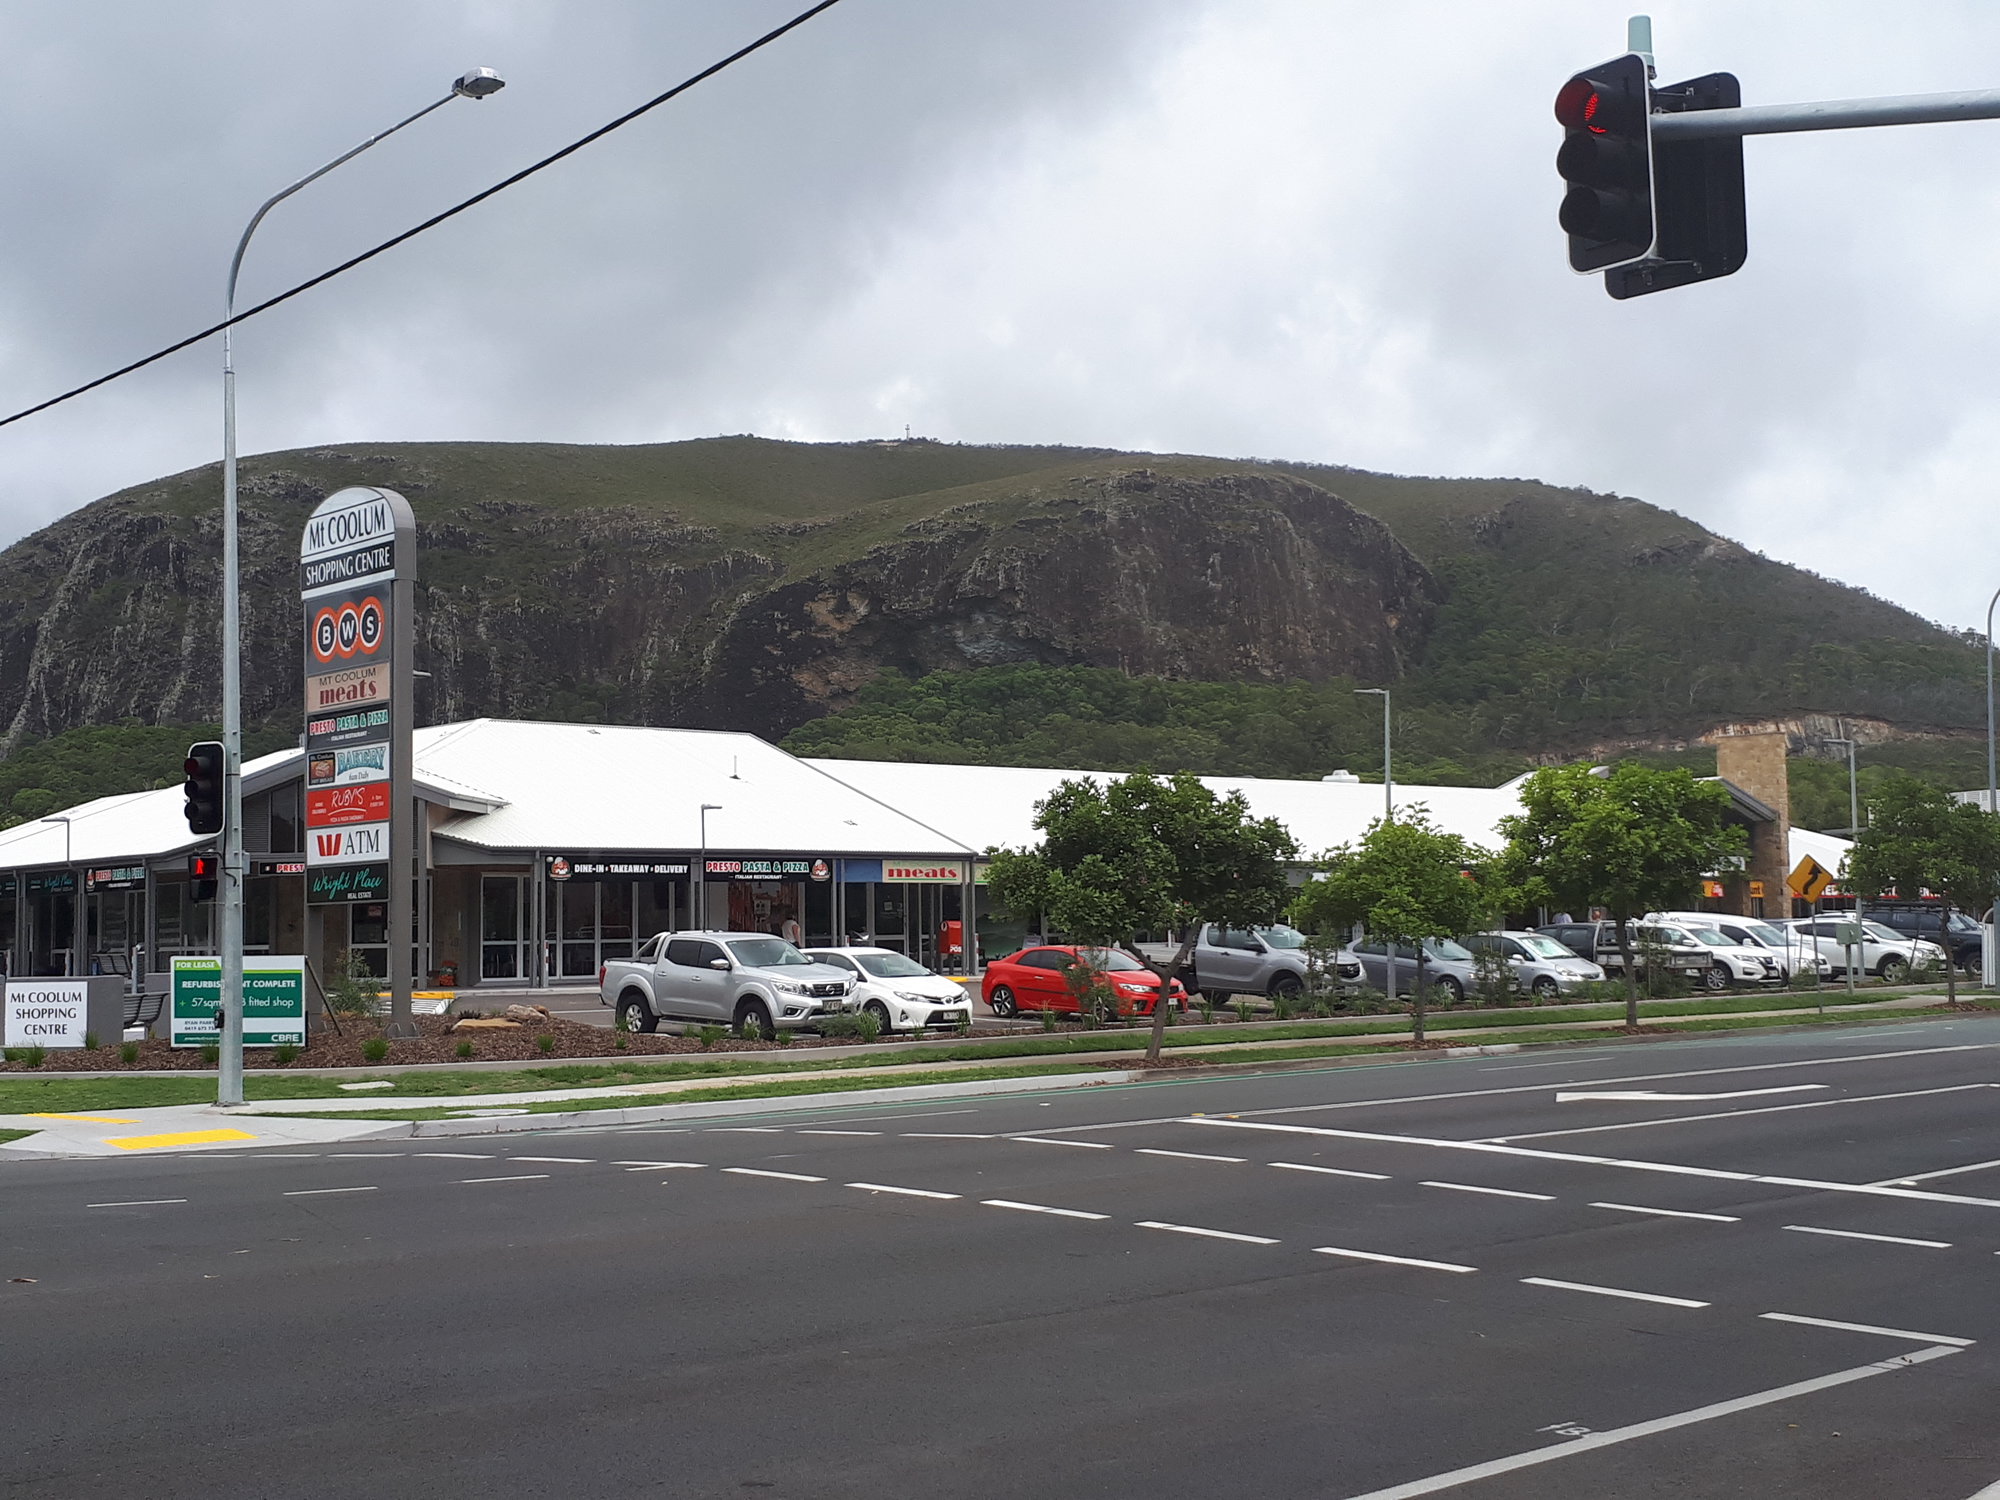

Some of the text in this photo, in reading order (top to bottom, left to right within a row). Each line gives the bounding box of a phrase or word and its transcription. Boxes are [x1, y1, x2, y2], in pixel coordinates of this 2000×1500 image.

[309, 503, 387, 551] Mt COOLUM
[306, 546, 390, 586] SHOPPING CENTRE
[322, 616, 376, 645] BWS
[320, 668, 376, 686] MT COOLUM
[320, 679, 376, 705] meats
[310, 709, 389, 735] PRESTO PASTA & PIZZA
[337, 746, 386, 776] BAKERY
[331, 787, 365, 807] RUBY'S
[344, 829, 380, 855] ATM
[277, 864, 304, 873] PREST
[574, 864, 688, 873] DINE-IN TAKEAWAY DELIVERY
[706, 861, 810, 873] PRESTO PASTA & PIZZA
[888, 867, 957, 878] meats
[313, 869, 350, 899] Wright
[253, 980, 296, 988] COMPLETE
[10, 992, 82, 1003] Mt COOLUM
[249, 996, 270, 1007] fitted
[272, 996, 294, 1009] shop
[16, 1008, 77, 1019] SHOPPING
[24, 1024, 68, 1035] CENTRE
[271, 1034, 299, 1042] CBRE
